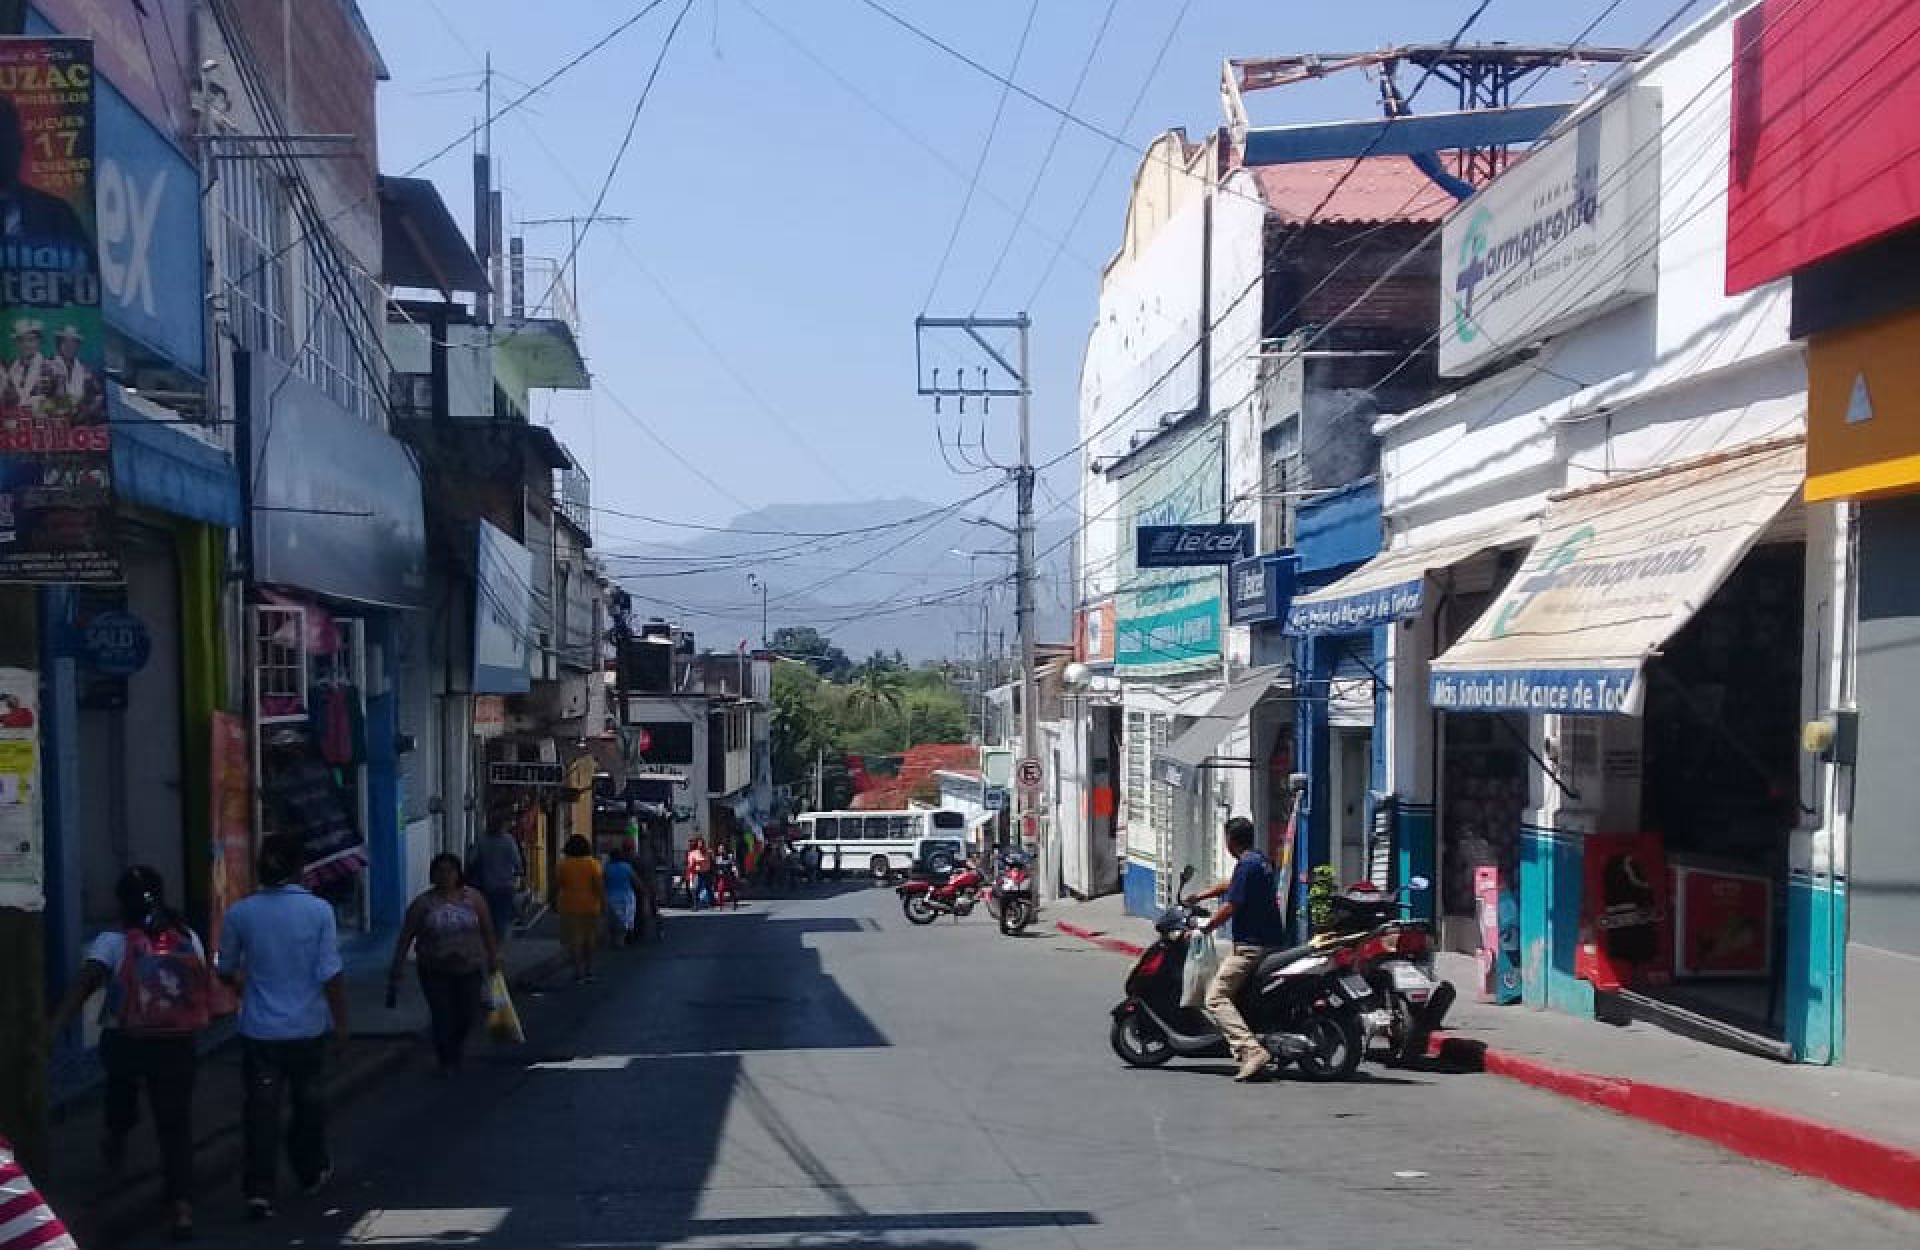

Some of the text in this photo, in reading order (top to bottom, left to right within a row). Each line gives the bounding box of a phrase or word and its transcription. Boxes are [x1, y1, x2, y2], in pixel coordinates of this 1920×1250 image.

[35, 131, 79, 157] 17
[1509, 677, 1569, 708] Alcance
[1573, 678, 1593, 709] de
